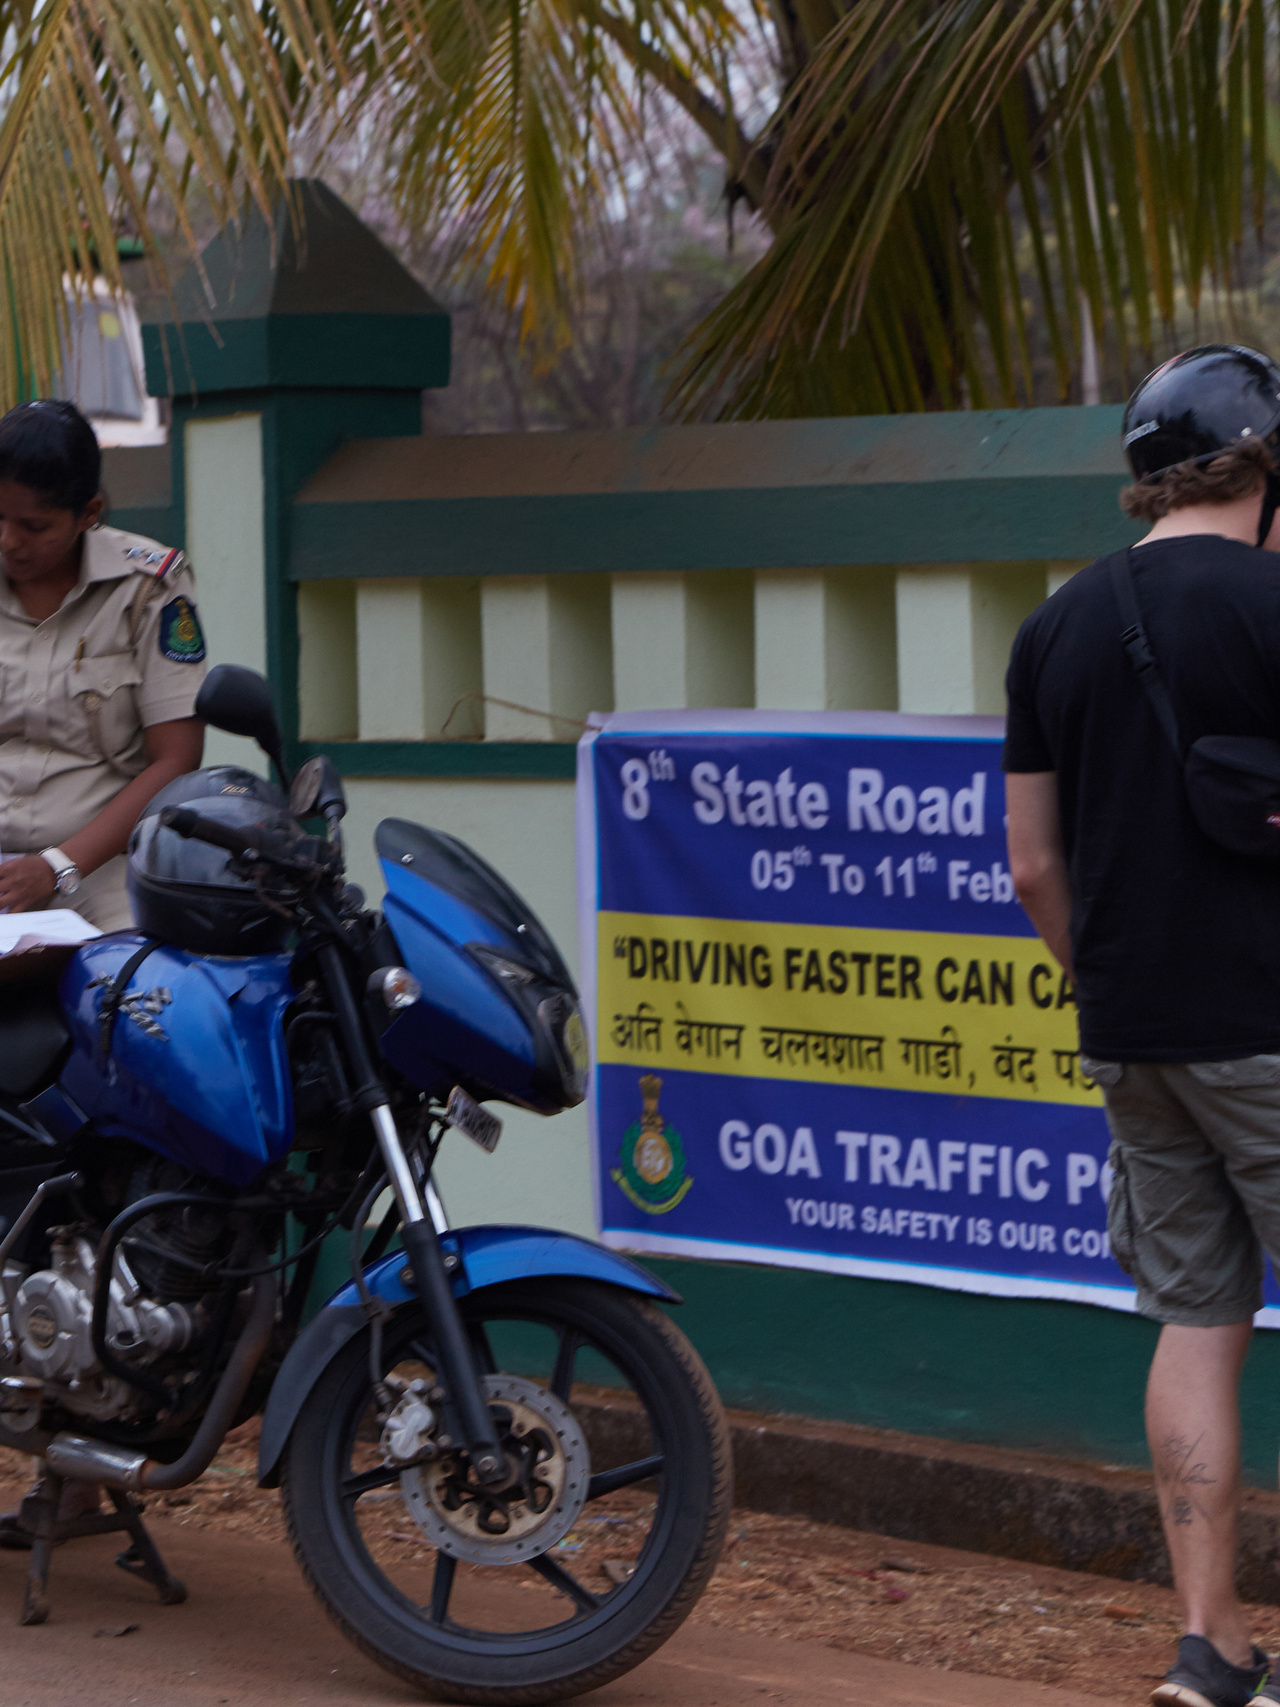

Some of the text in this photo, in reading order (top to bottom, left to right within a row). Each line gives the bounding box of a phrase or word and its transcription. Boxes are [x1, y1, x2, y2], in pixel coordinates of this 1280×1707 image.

[690, 761, 830, 830] State
[847, 767, 988, 836] Road
[820, 853, 866, 895] To
[947, 861, 1020, 904] Feb
[783, 946, 924, 1001] FASTER
[934, 957, 1016, 1007] CAN
[610, 1002, 663, 1052] अति
[718, 1119, 822, 1179] GOA
[834, 1130, 1051, 1203] TRAFFIC
[784, 1197, 857, 1232] YOUR
[860, 1205, 962, 1243] SAFETY
[966, 1216, 994, 1247] IS
[998, 1220, 1058, 1254] OUR
